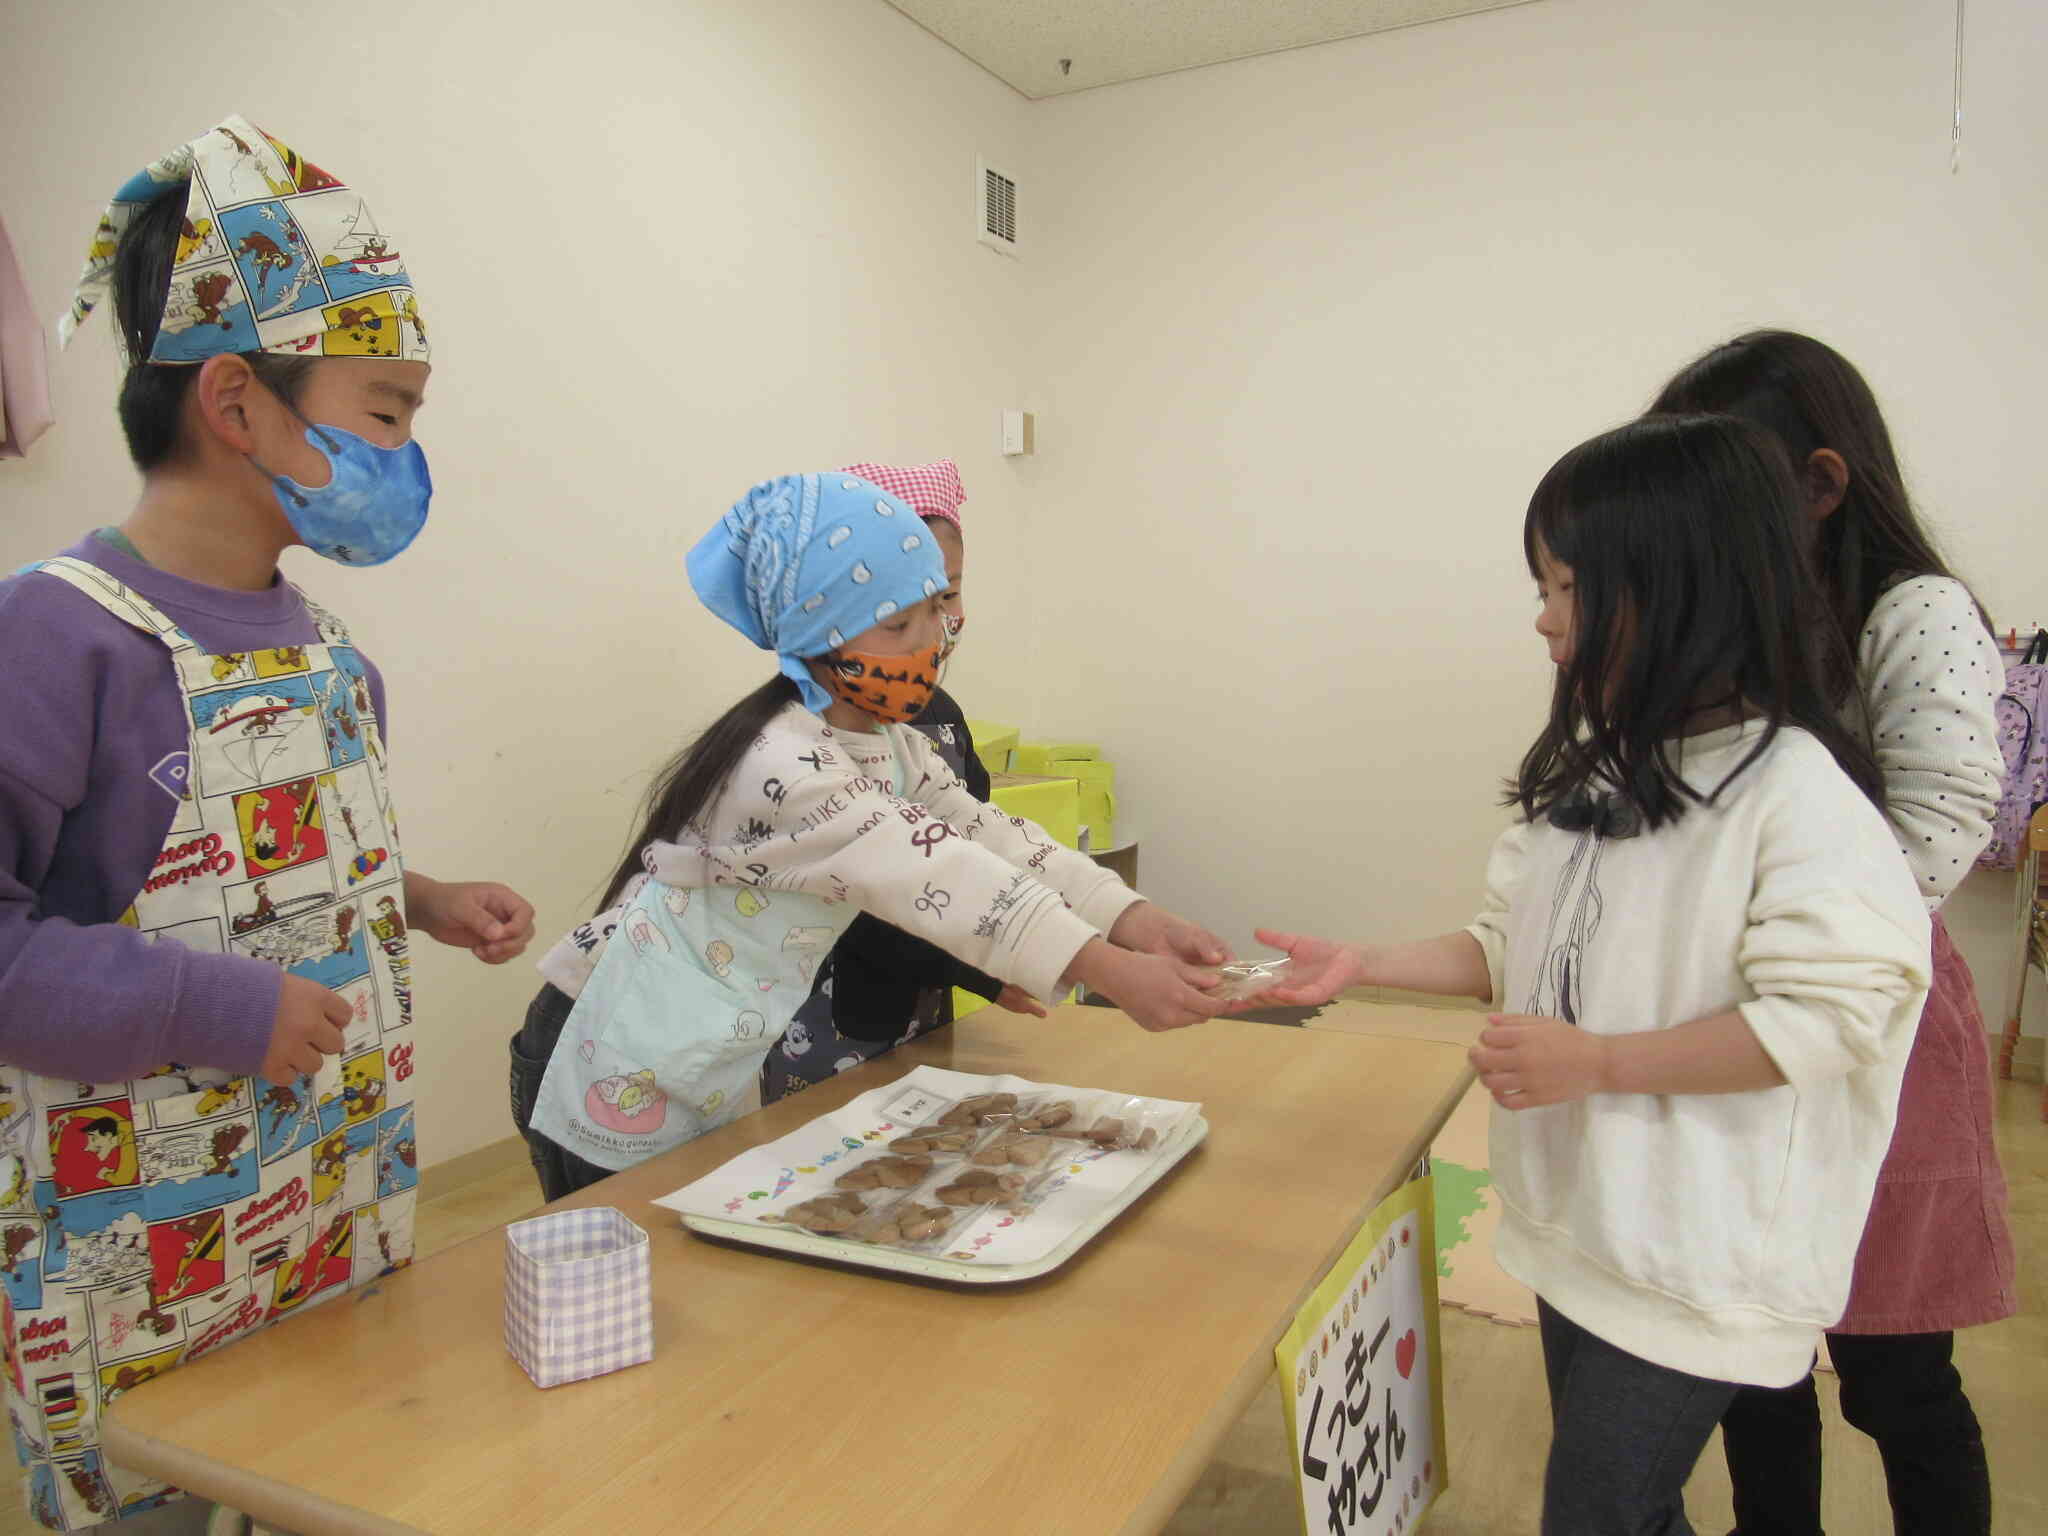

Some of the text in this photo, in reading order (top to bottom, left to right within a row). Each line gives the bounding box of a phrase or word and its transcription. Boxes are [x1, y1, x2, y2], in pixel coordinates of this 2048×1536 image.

[143, 852, 236, 895] Curious
[914, 881, 951, 921] 95
[235, 1191, 309, 1246] Curious
[1327, 1387, 1407, 1536] やさん
